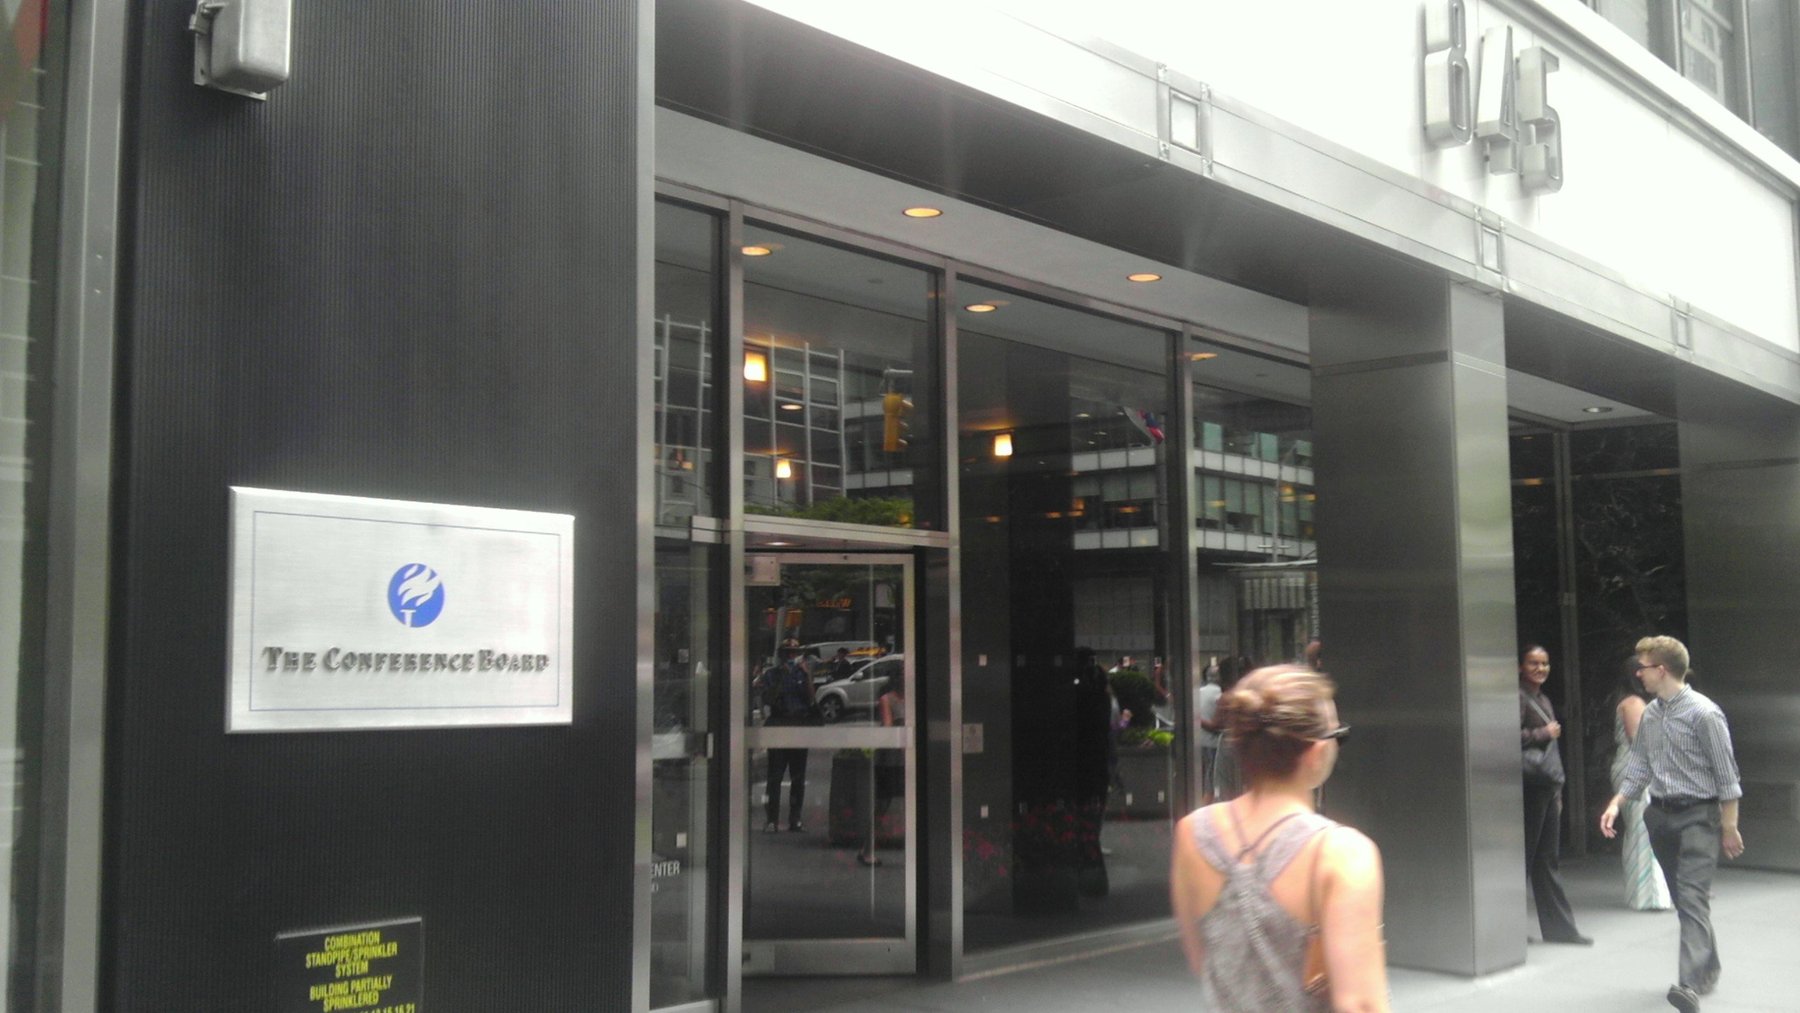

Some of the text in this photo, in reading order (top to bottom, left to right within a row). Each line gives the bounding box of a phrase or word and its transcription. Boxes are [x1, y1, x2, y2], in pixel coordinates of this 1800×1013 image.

[261, 646, 549, 672] THE CONFERENCE BOARD
[324, 931, 380, 951] COMBINATION
[335, 960, 369, 978] SYSTEM
[310, 975, 393, 1001] BUILDING PARTIALLY
[323, 991, 379, 1012] SPRINKLERED
